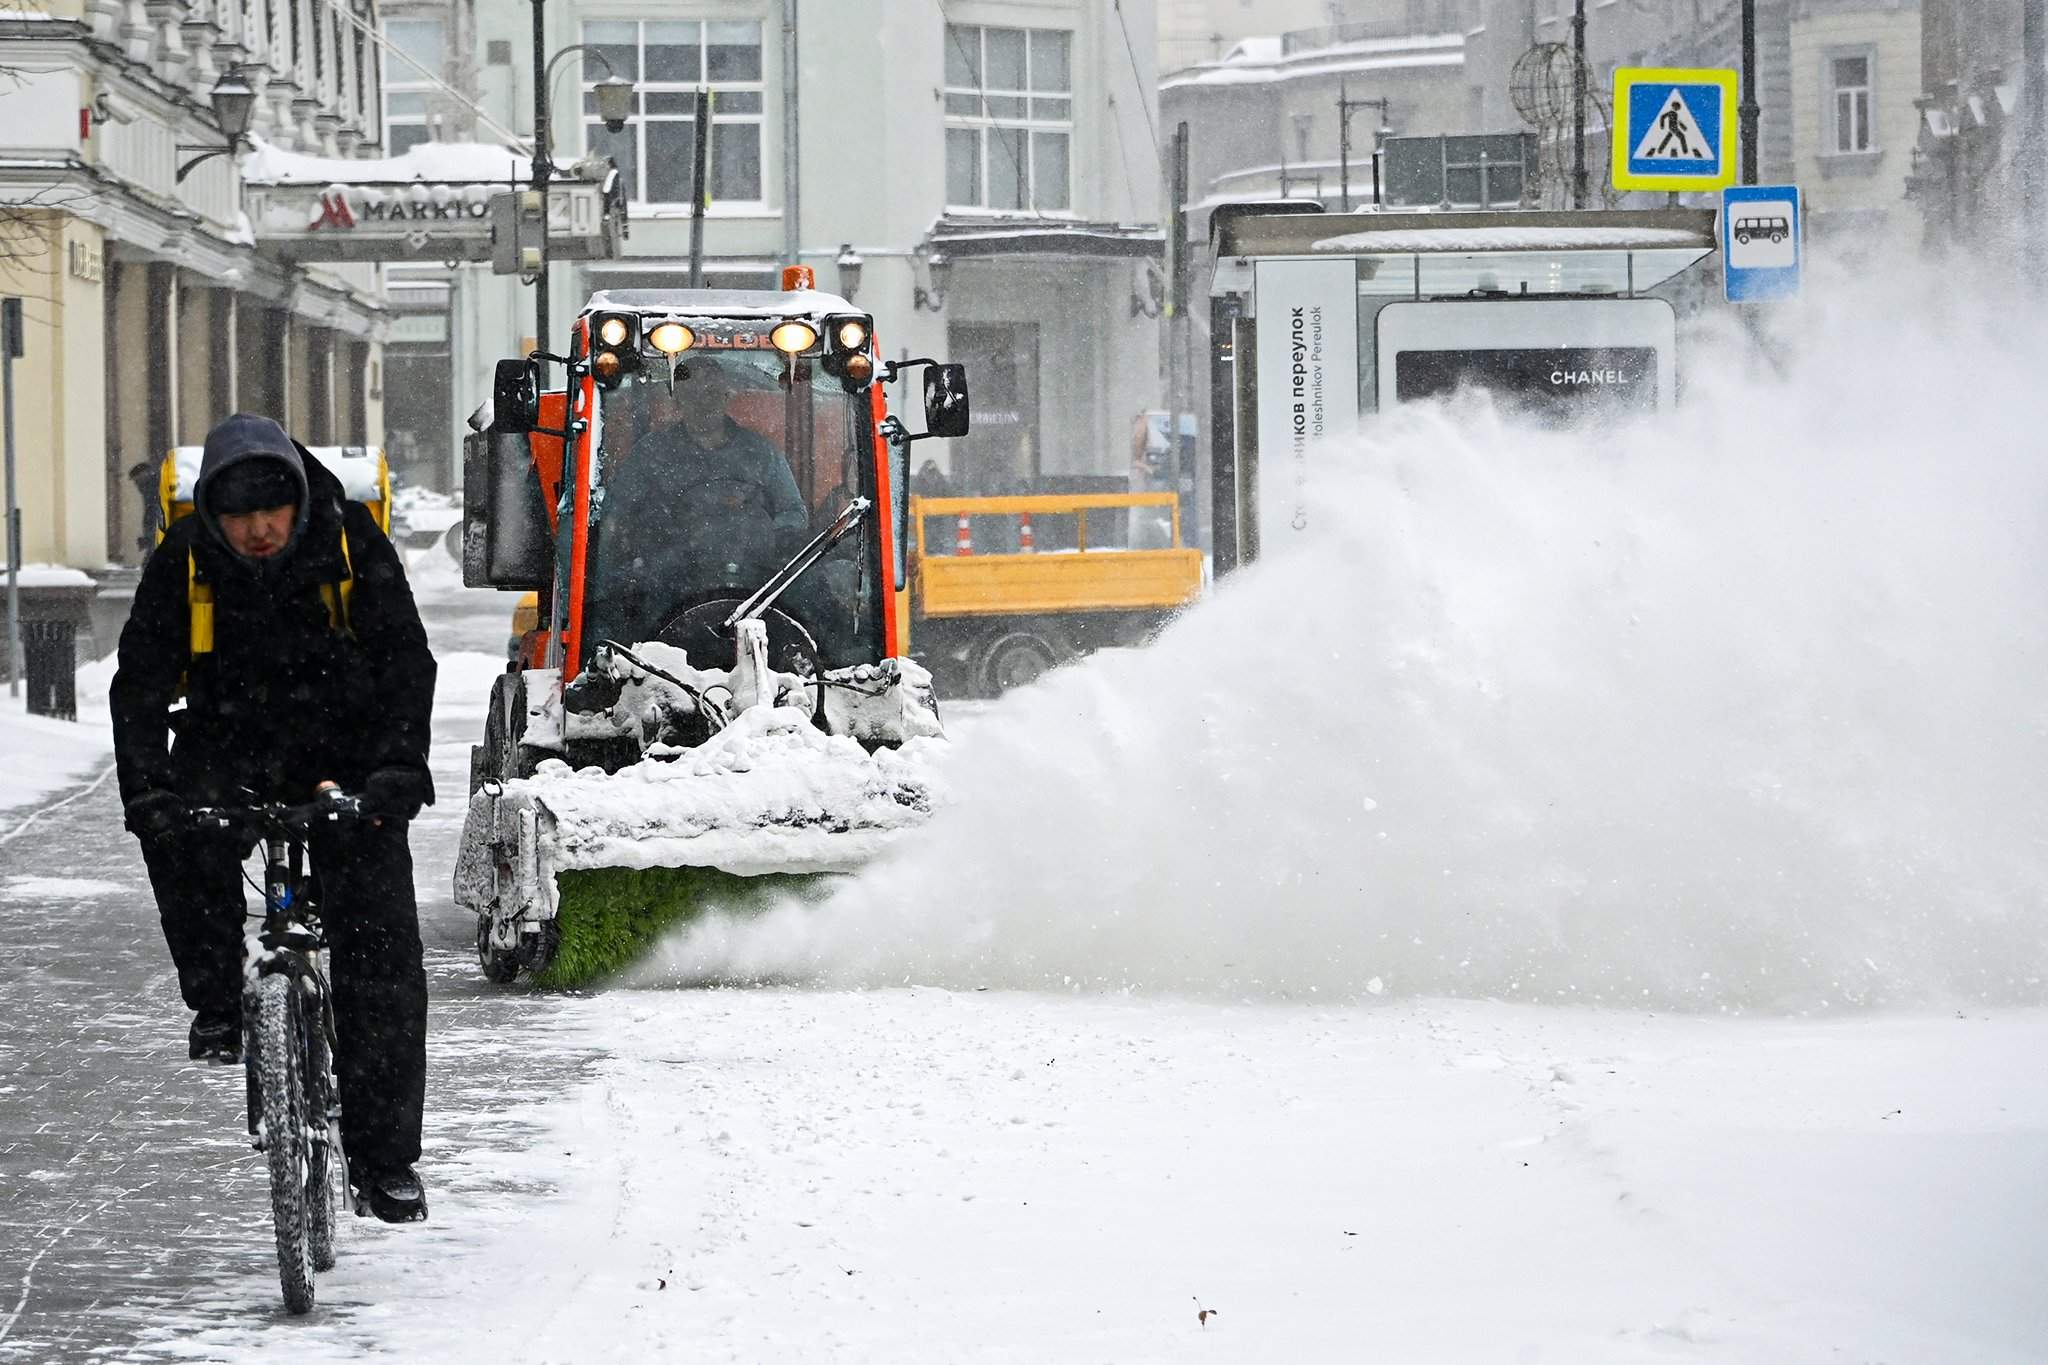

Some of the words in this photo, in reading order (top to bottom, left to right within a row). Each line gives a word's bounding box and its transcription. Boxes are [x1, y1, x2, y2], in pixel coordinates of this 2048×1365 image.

[1291, 306, 1308, 398] переулок
[1309, 306, 1323, 362] Pereulok
[1311, 365, 1324, 441] toleshnikov
[1550, 369, 1629, 385] CHANEL
